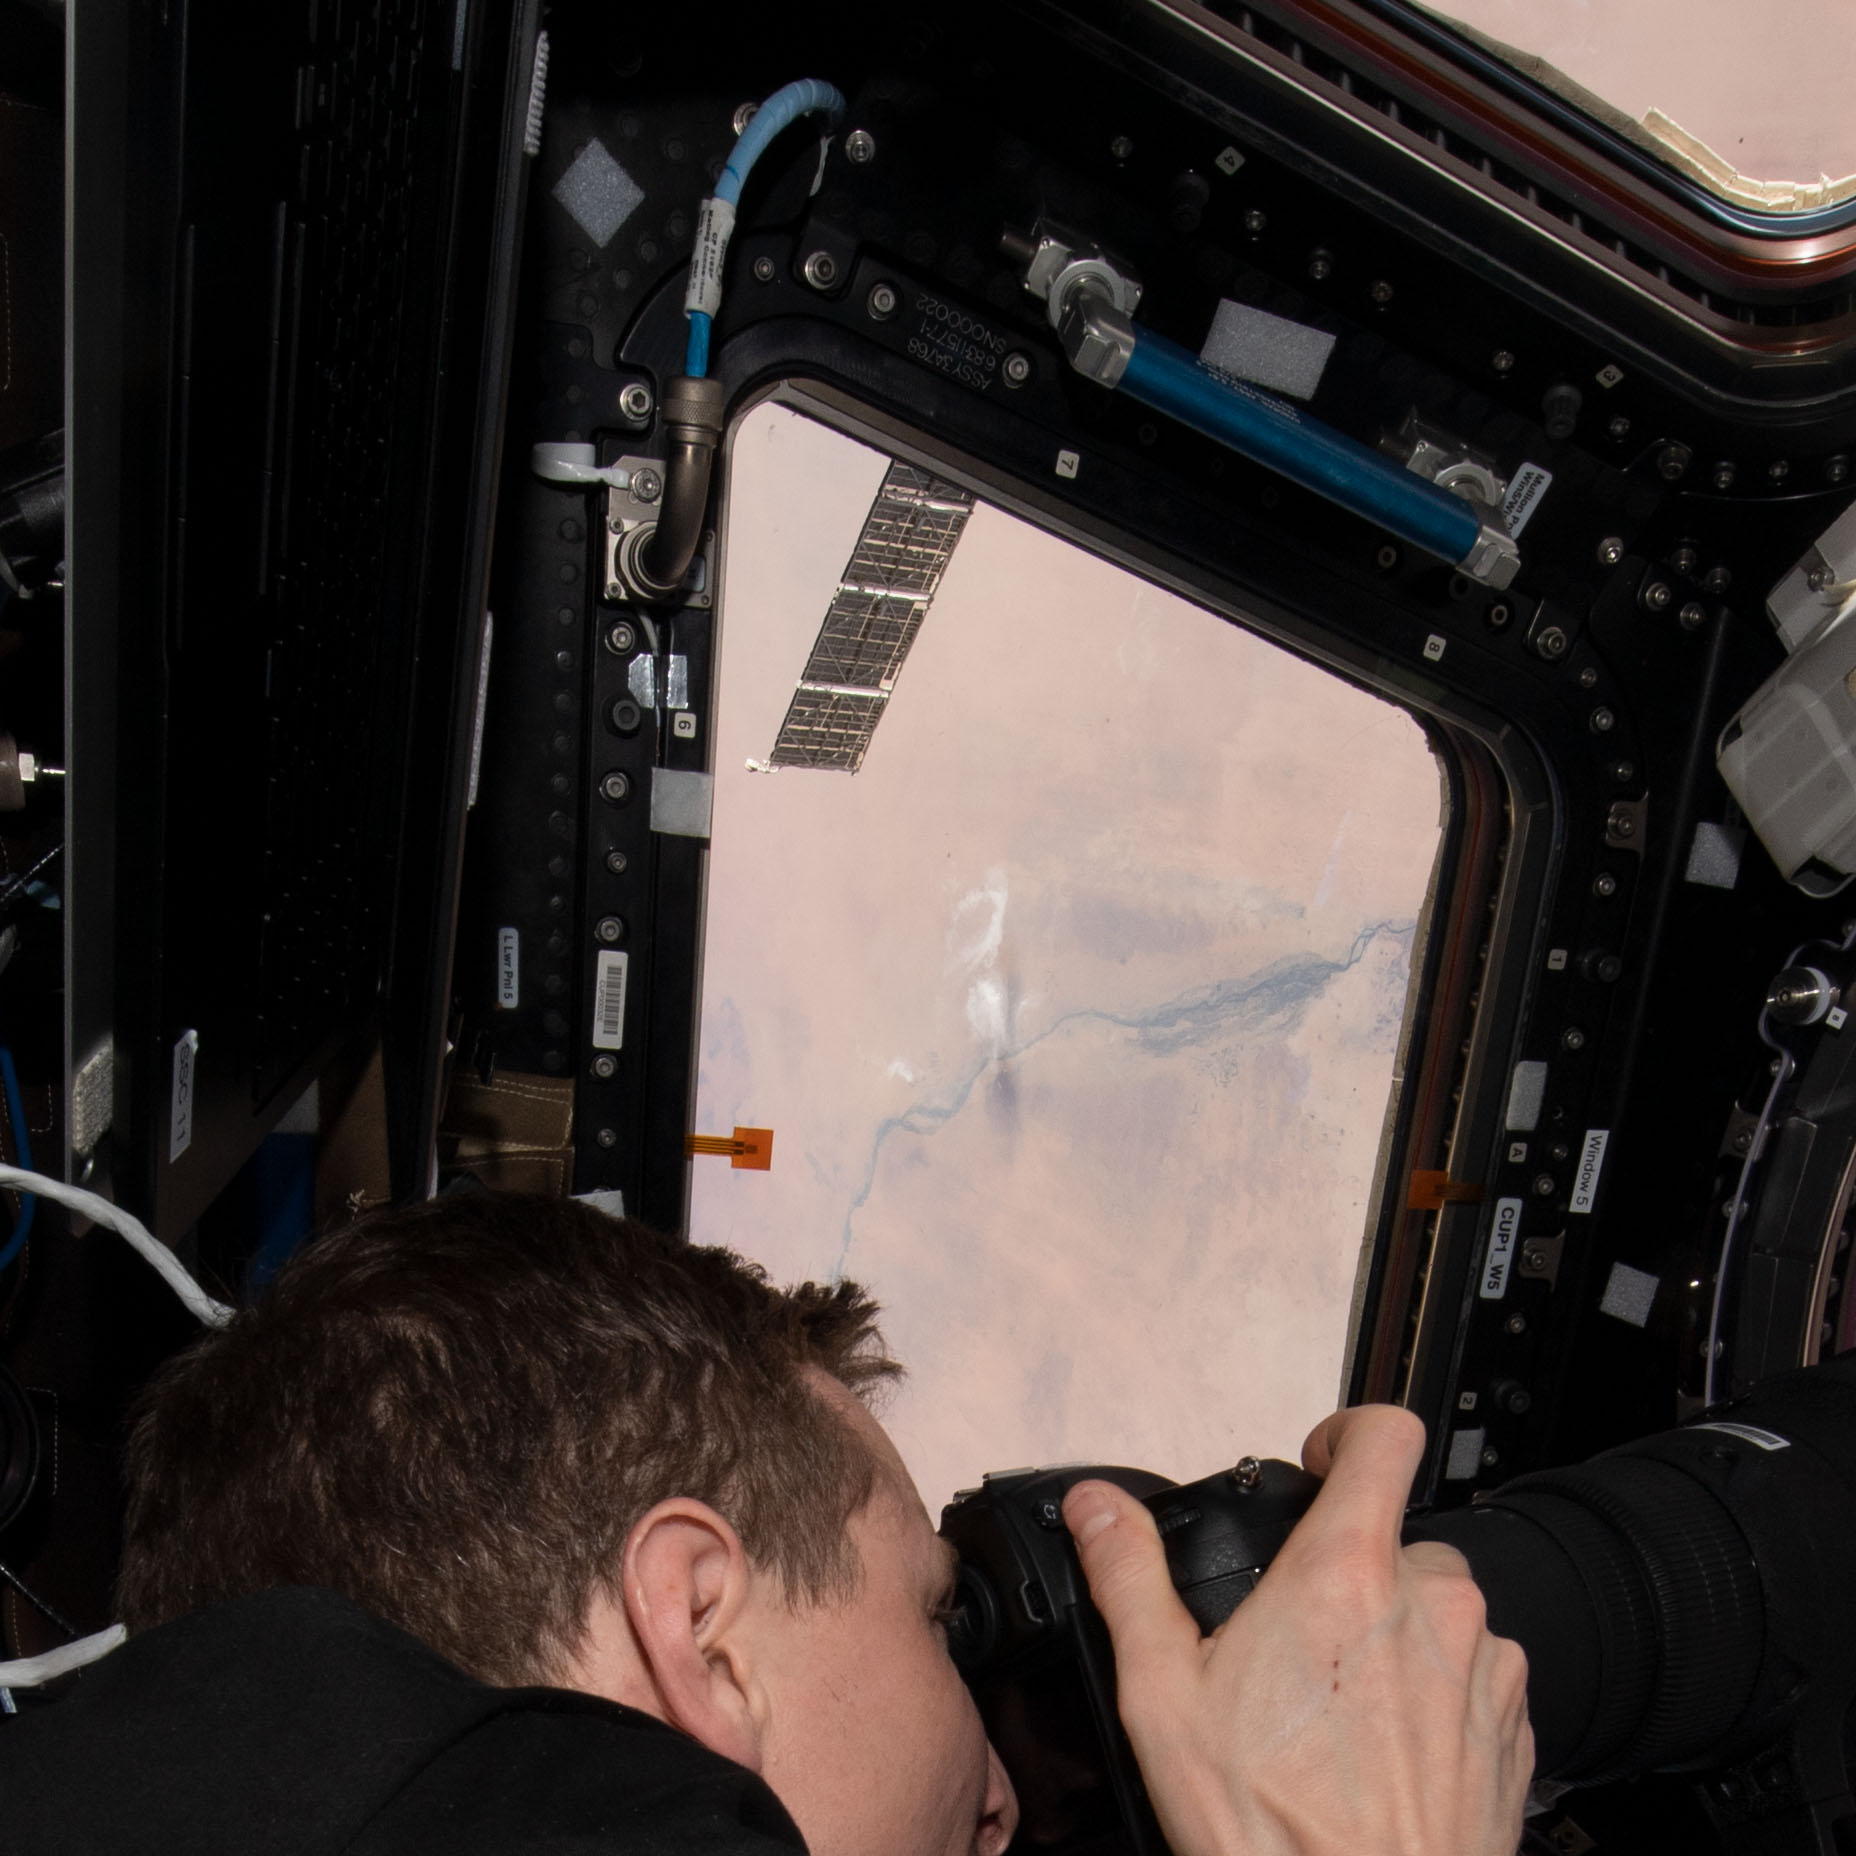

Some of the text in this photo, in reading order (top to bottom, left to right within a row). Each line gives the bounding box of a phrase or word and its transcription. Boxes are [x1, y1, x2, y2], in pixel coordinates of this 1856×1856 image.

[950, 360, 993, 391] ASSY
[1060, 458, 1074, 470] 7
[1514, 471, 1546, 514] Mullion
[1427, 641, 1440, 652] 8
[677, 720, 691, 729] 6
[1551, 954, 1562, 962] 1
[502, 970, 513, 989] Pnl
[174, 1044, 192, 1106] SSC
[1511, 1147, 1523, 1159] A
[1575, 1134, 1602, 1206] Window 5
[1485, 1205, 1516, 1291] CUP1_W5
[1462, 1396, 1473, 1405] 2
